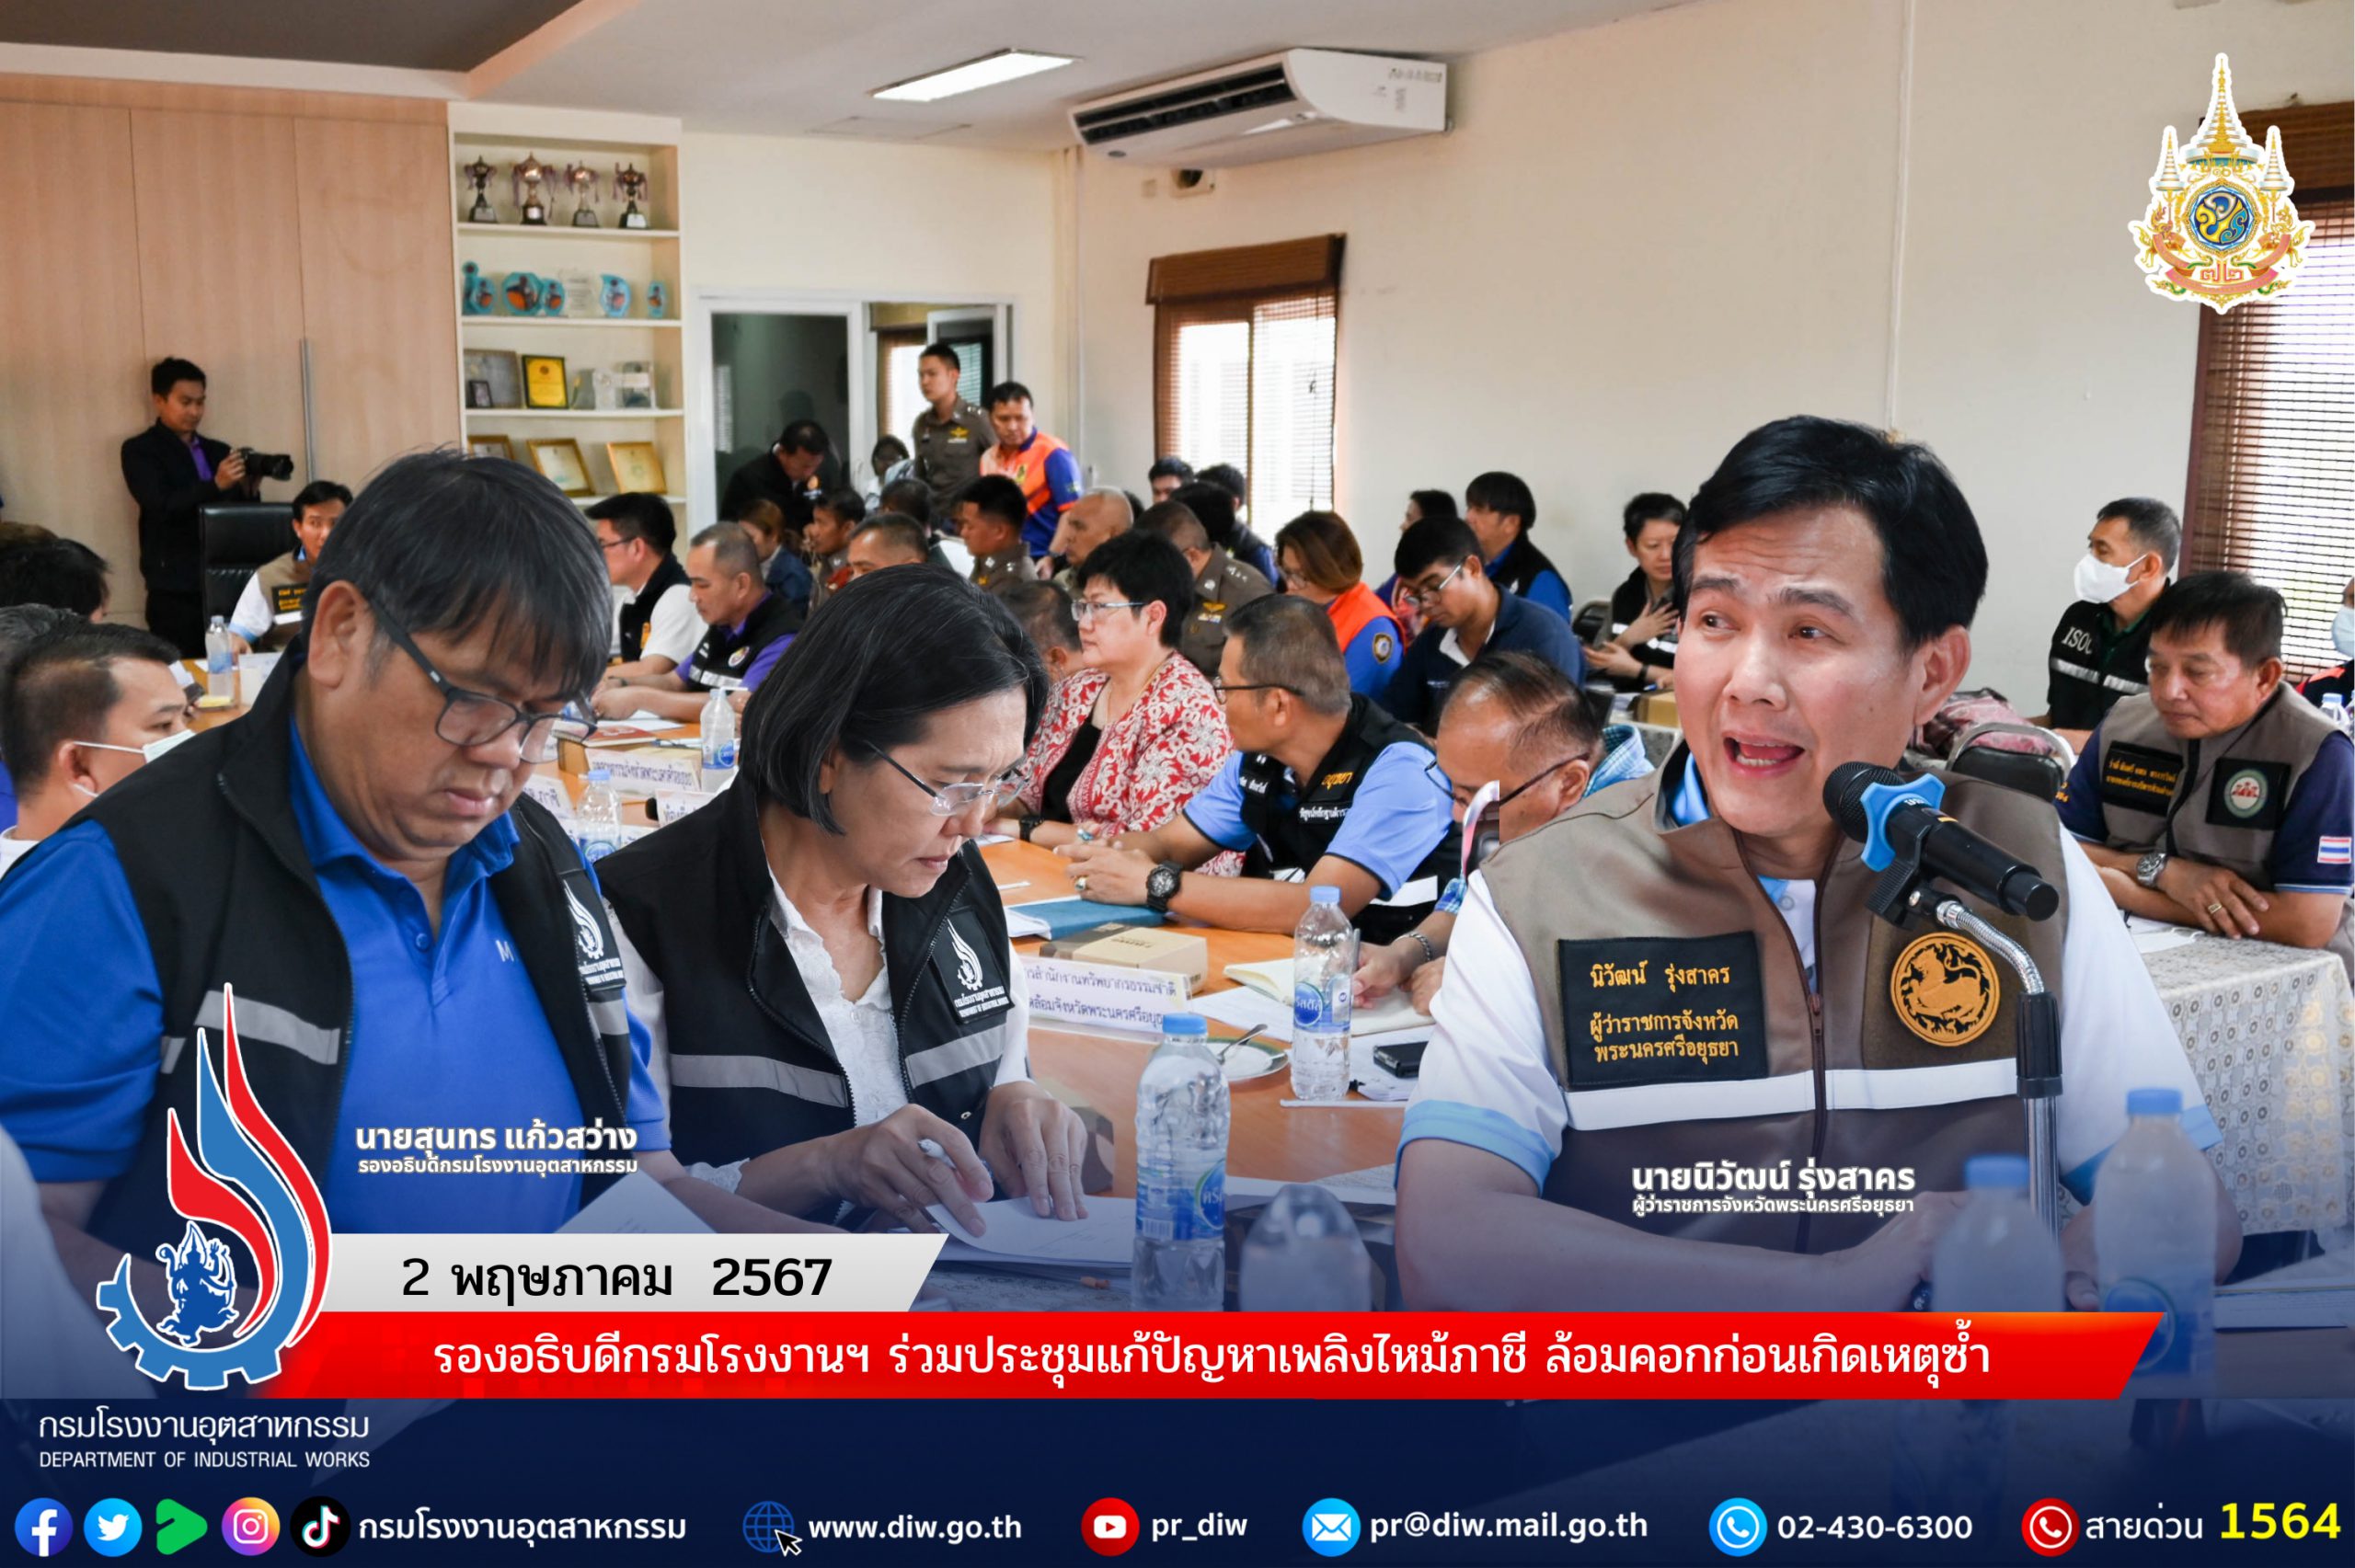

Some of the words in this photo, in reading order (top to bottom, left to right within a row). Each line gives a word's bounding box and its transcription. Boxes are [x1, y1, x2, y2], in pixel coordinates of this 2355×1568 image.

[1590, 959, 1648, 988] นิวัฒน์
[1664, 963, 1730, 993] รุ่งสาคร
[1590, 1008, 1739, 1044] ผู้ว่าราชการจังหวัด
[1594, 1034, 1739, 1065] พระนครศรีอยุธยา
